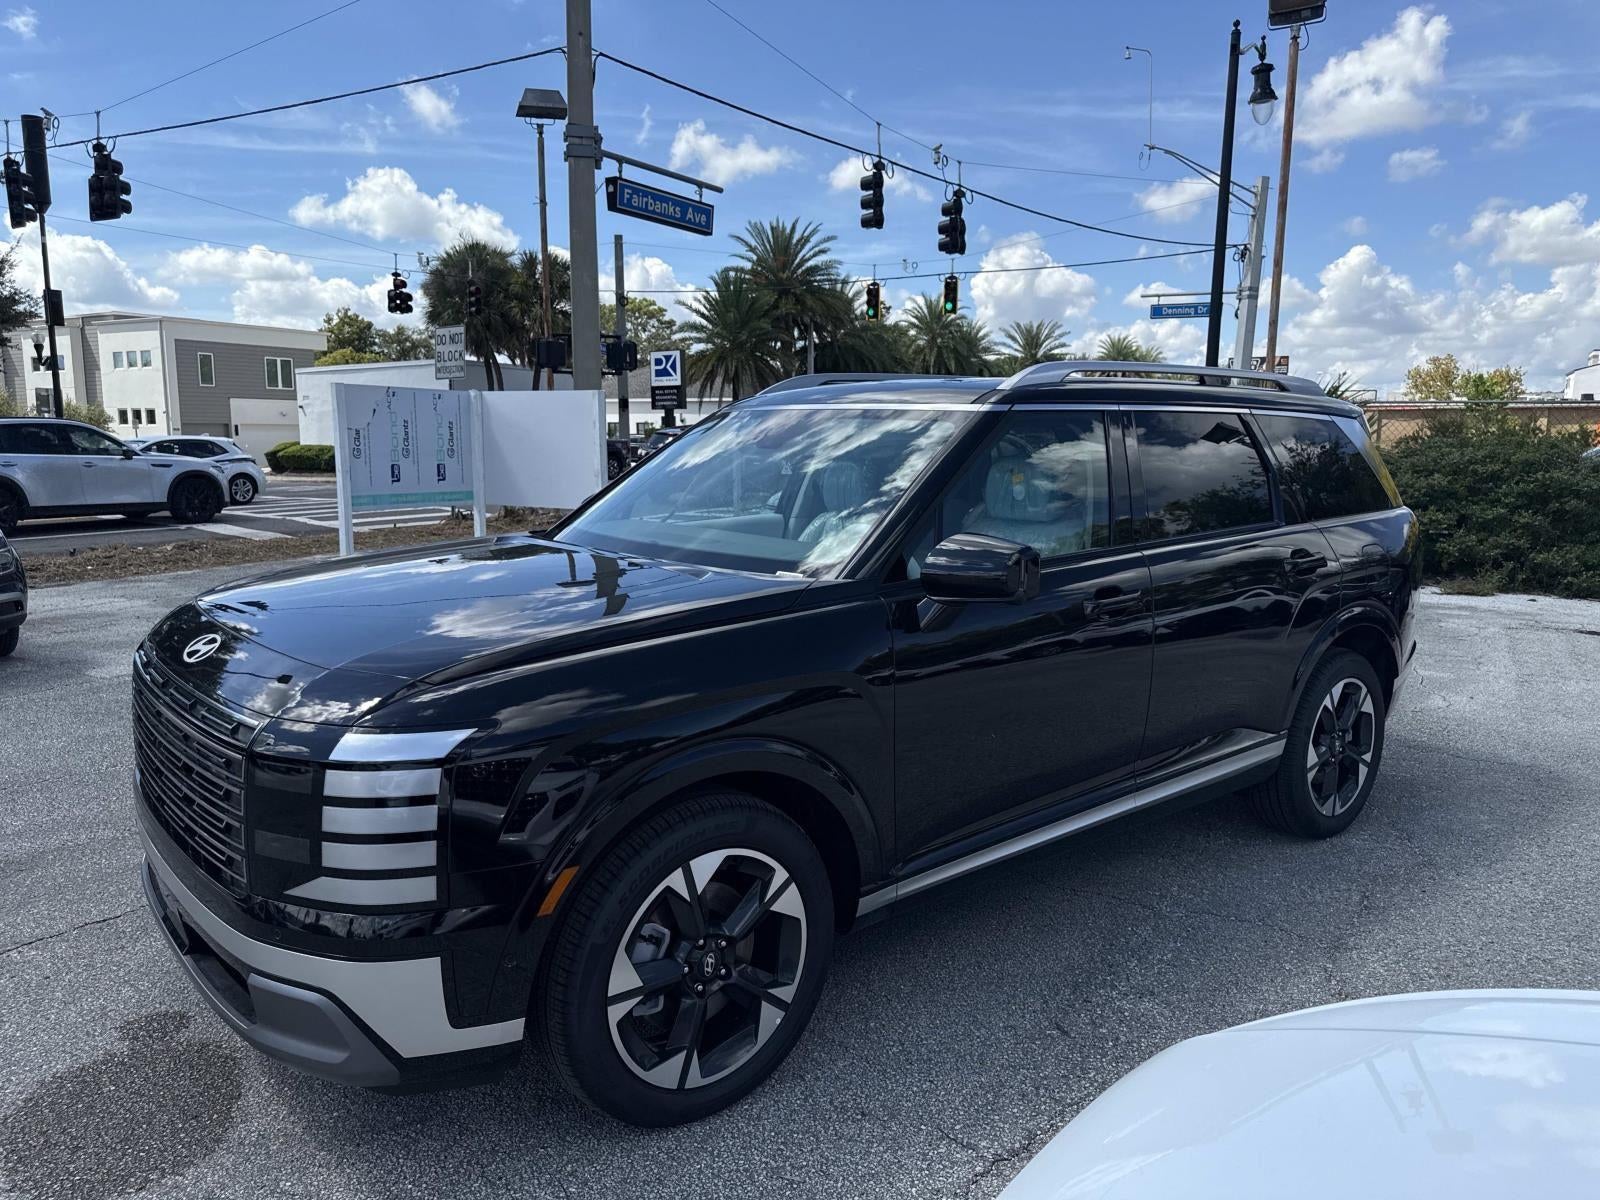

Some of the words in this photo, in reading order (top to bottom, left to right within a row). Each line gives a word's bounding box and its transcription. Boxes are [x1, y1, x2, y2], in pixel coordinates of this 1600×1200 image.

[624, 188, 681, 218] Fairbanks
[686, 207, 707, 225] Ave
[1162, 306, 1195, 315] Denning
[1197, 305, 1208, 314] Dr
[436, 334, 447, 346] DO
[449, 332, 464, 345] NOT
[436, 350, 464, 362] BLOCK
[402, 419, 410, 447] Glantz
